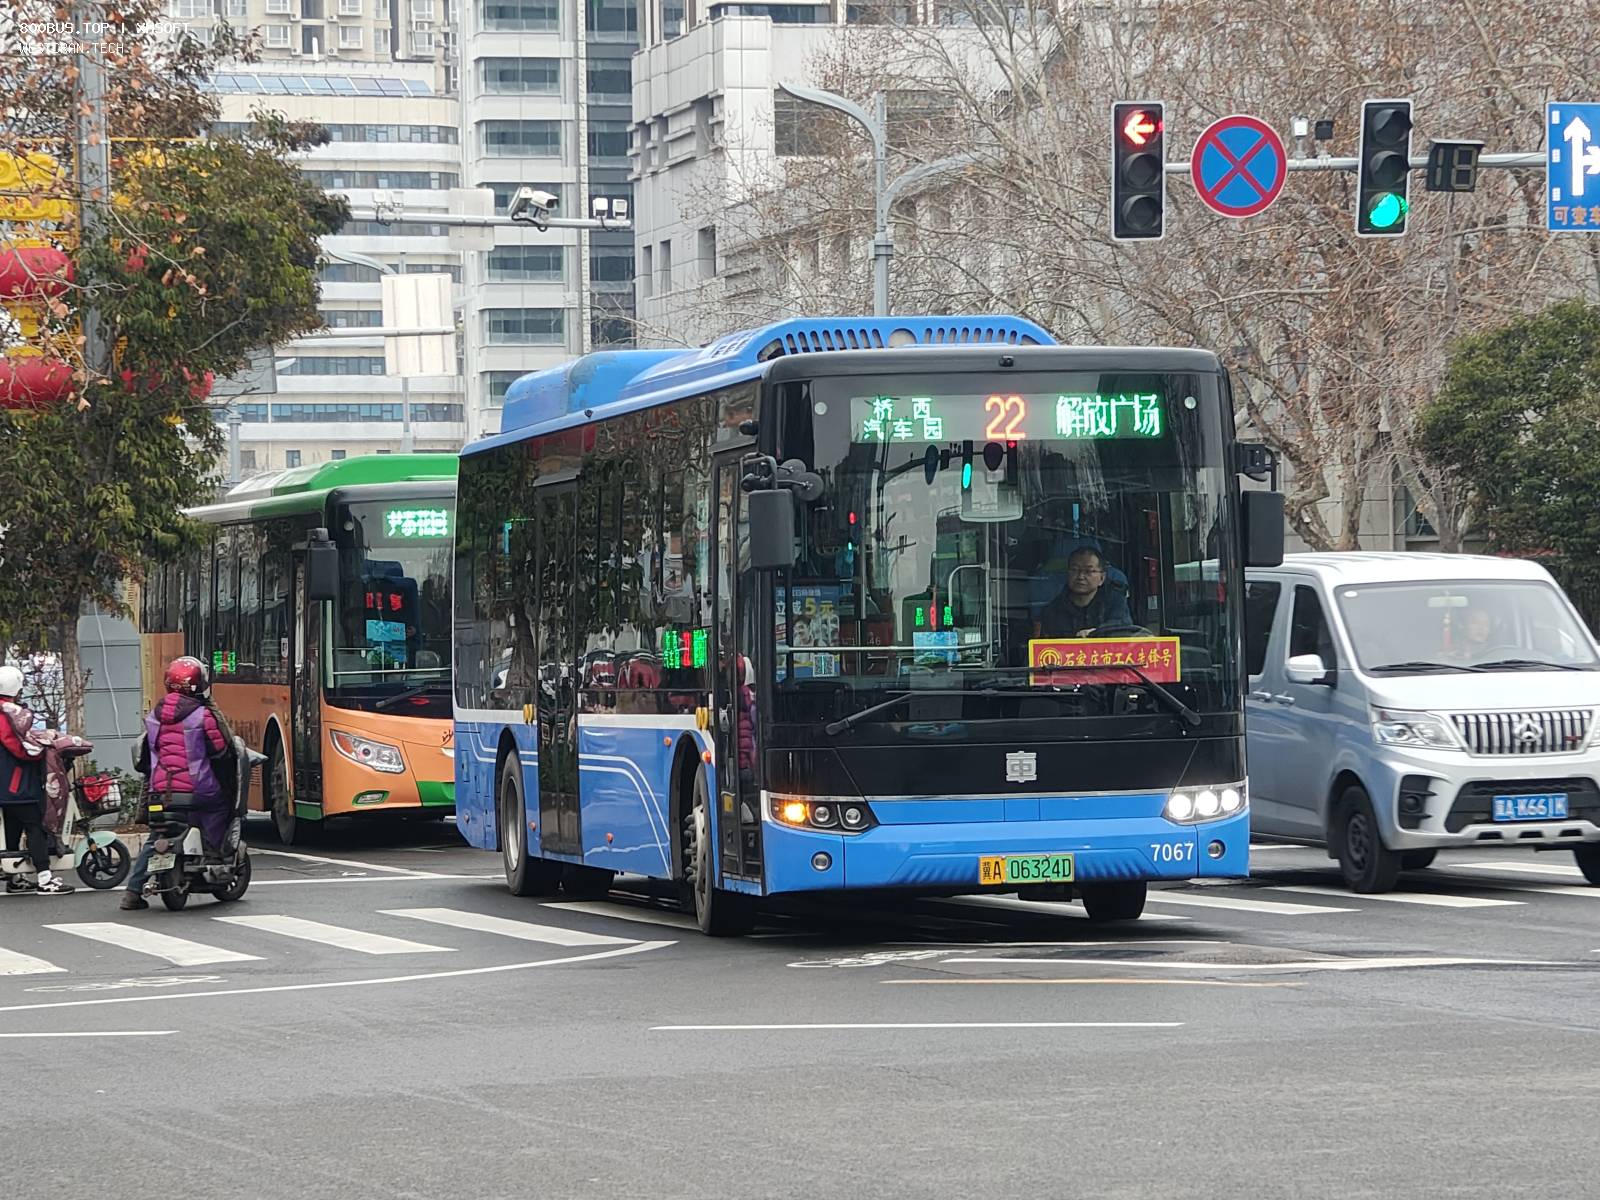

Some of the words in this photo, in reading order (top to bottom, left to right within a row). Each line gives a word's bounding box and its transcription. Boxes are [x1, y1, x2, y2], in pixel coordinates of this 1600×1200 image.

[985, 395, 1026, 440] 22
[1055, 395, 1160, 437] 解放广场
[863, 418, 943, 440] 汽车园
[1064, 648, 1172, 668] 石家庄市工人先锋号
[1150, 844, 1195, 862] 7067
[1010, 858, 1072, 879] 06324D
